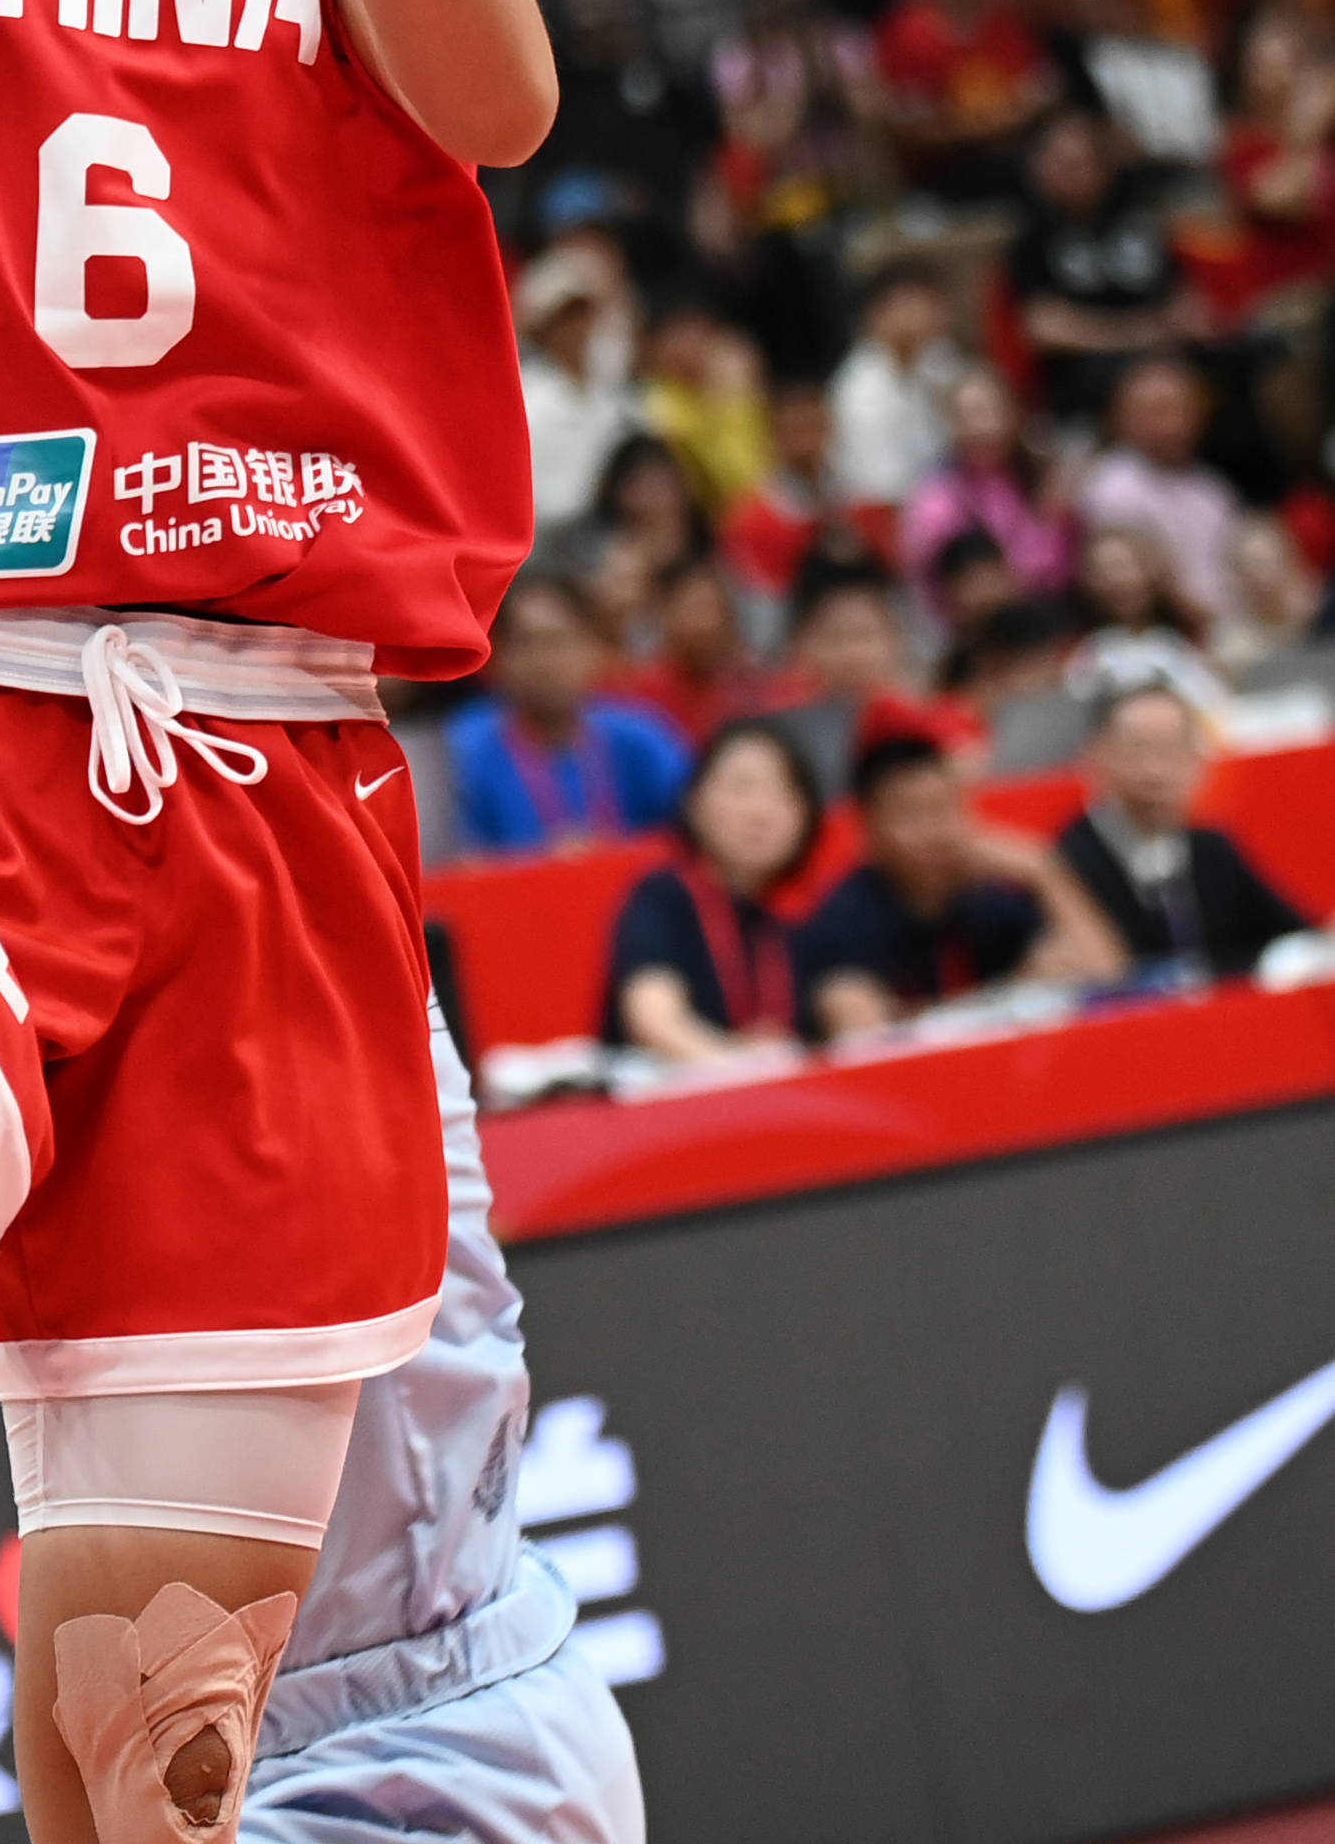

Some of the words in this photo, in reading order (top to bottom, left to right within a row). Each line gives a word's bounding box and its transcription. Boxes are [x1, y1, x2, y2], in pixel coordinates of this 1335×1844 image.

[34, 112, 197, 369] 6
[113, 441, 365, 515] 中国银联
[119, 516, 223, 557] China
